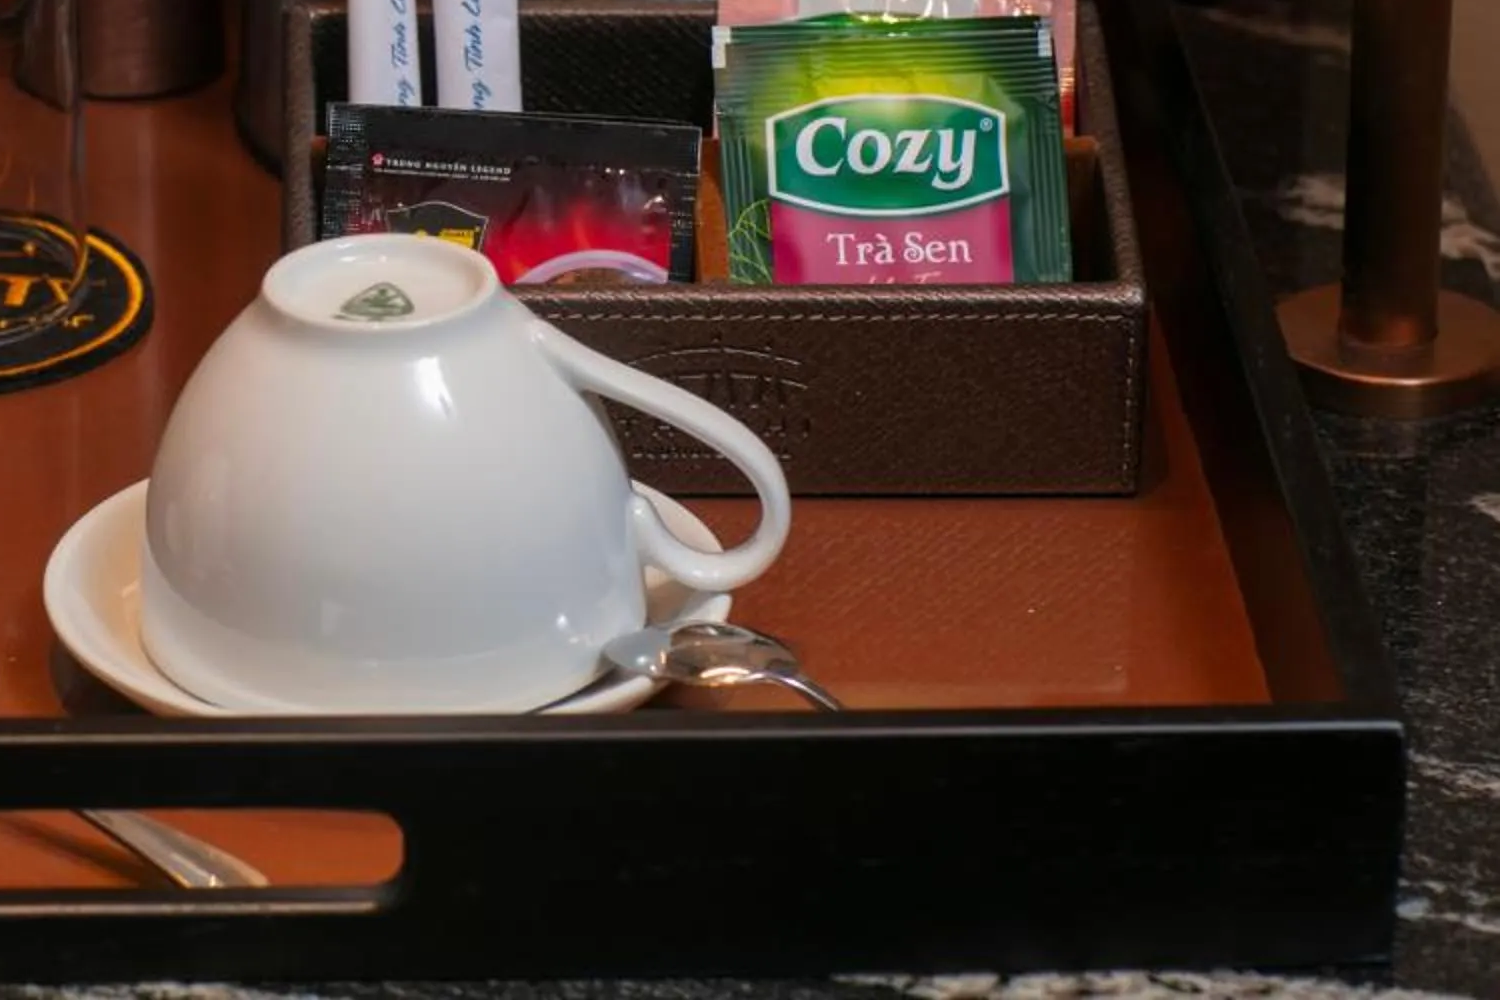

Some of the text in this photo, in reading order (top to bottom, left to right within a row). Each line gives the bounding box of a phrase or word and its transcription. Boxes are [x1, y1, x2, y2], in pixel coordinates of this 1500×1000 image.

[386, 158, 421, 169] TRUNG
[470, 164, 512, 175] LEGEND
[826, 231, 973, 265] Trà Sen
